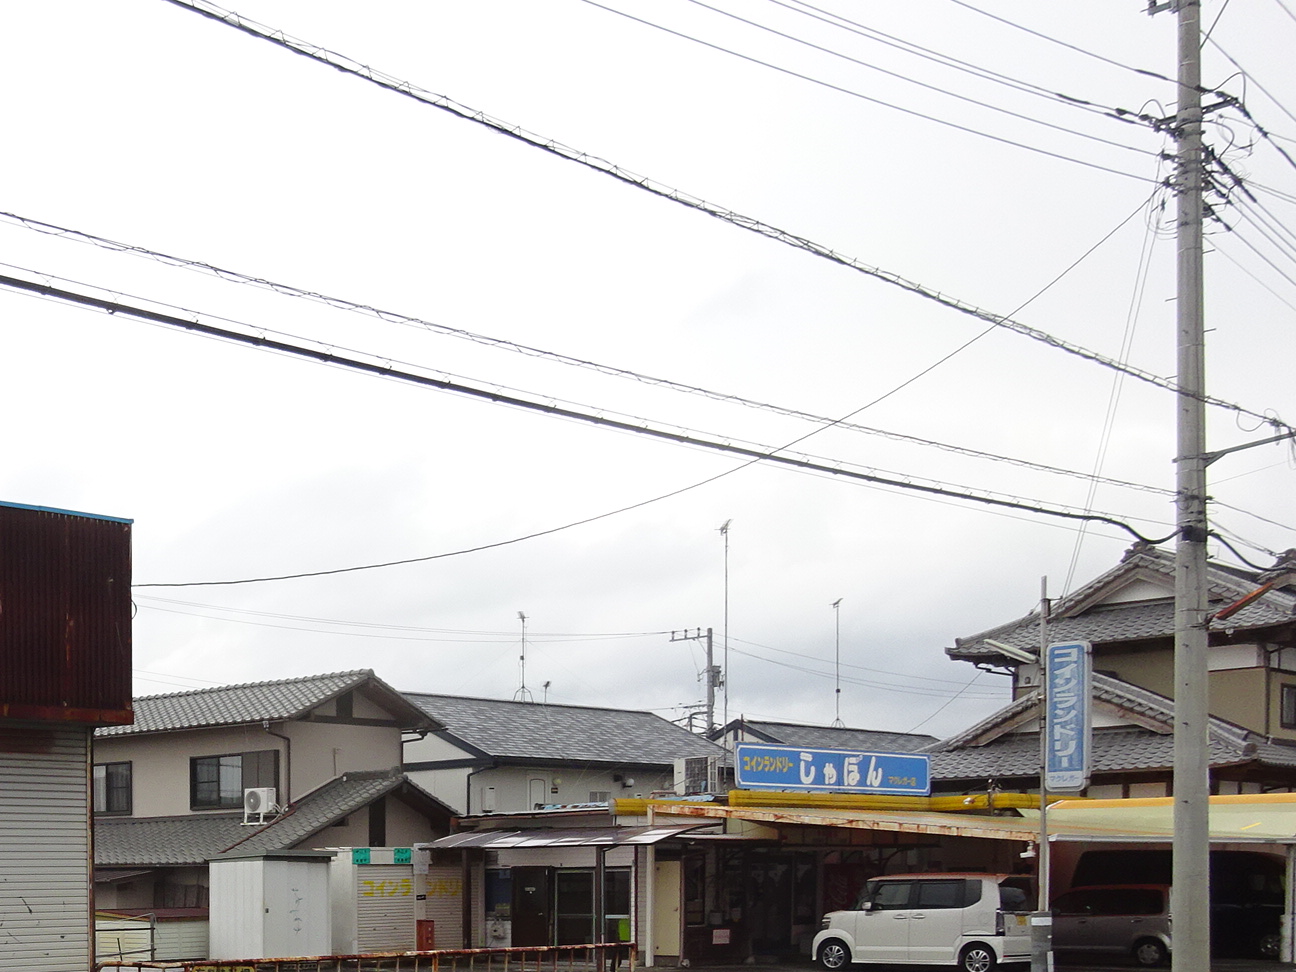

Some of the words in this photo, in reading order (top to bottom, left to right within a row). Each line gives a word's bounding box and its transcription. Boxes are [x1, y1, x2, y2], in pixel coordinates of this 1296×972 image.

[1053, 647, 1078, 768] コインランドリー
[743, 756, 794, 773] コインランドリー
